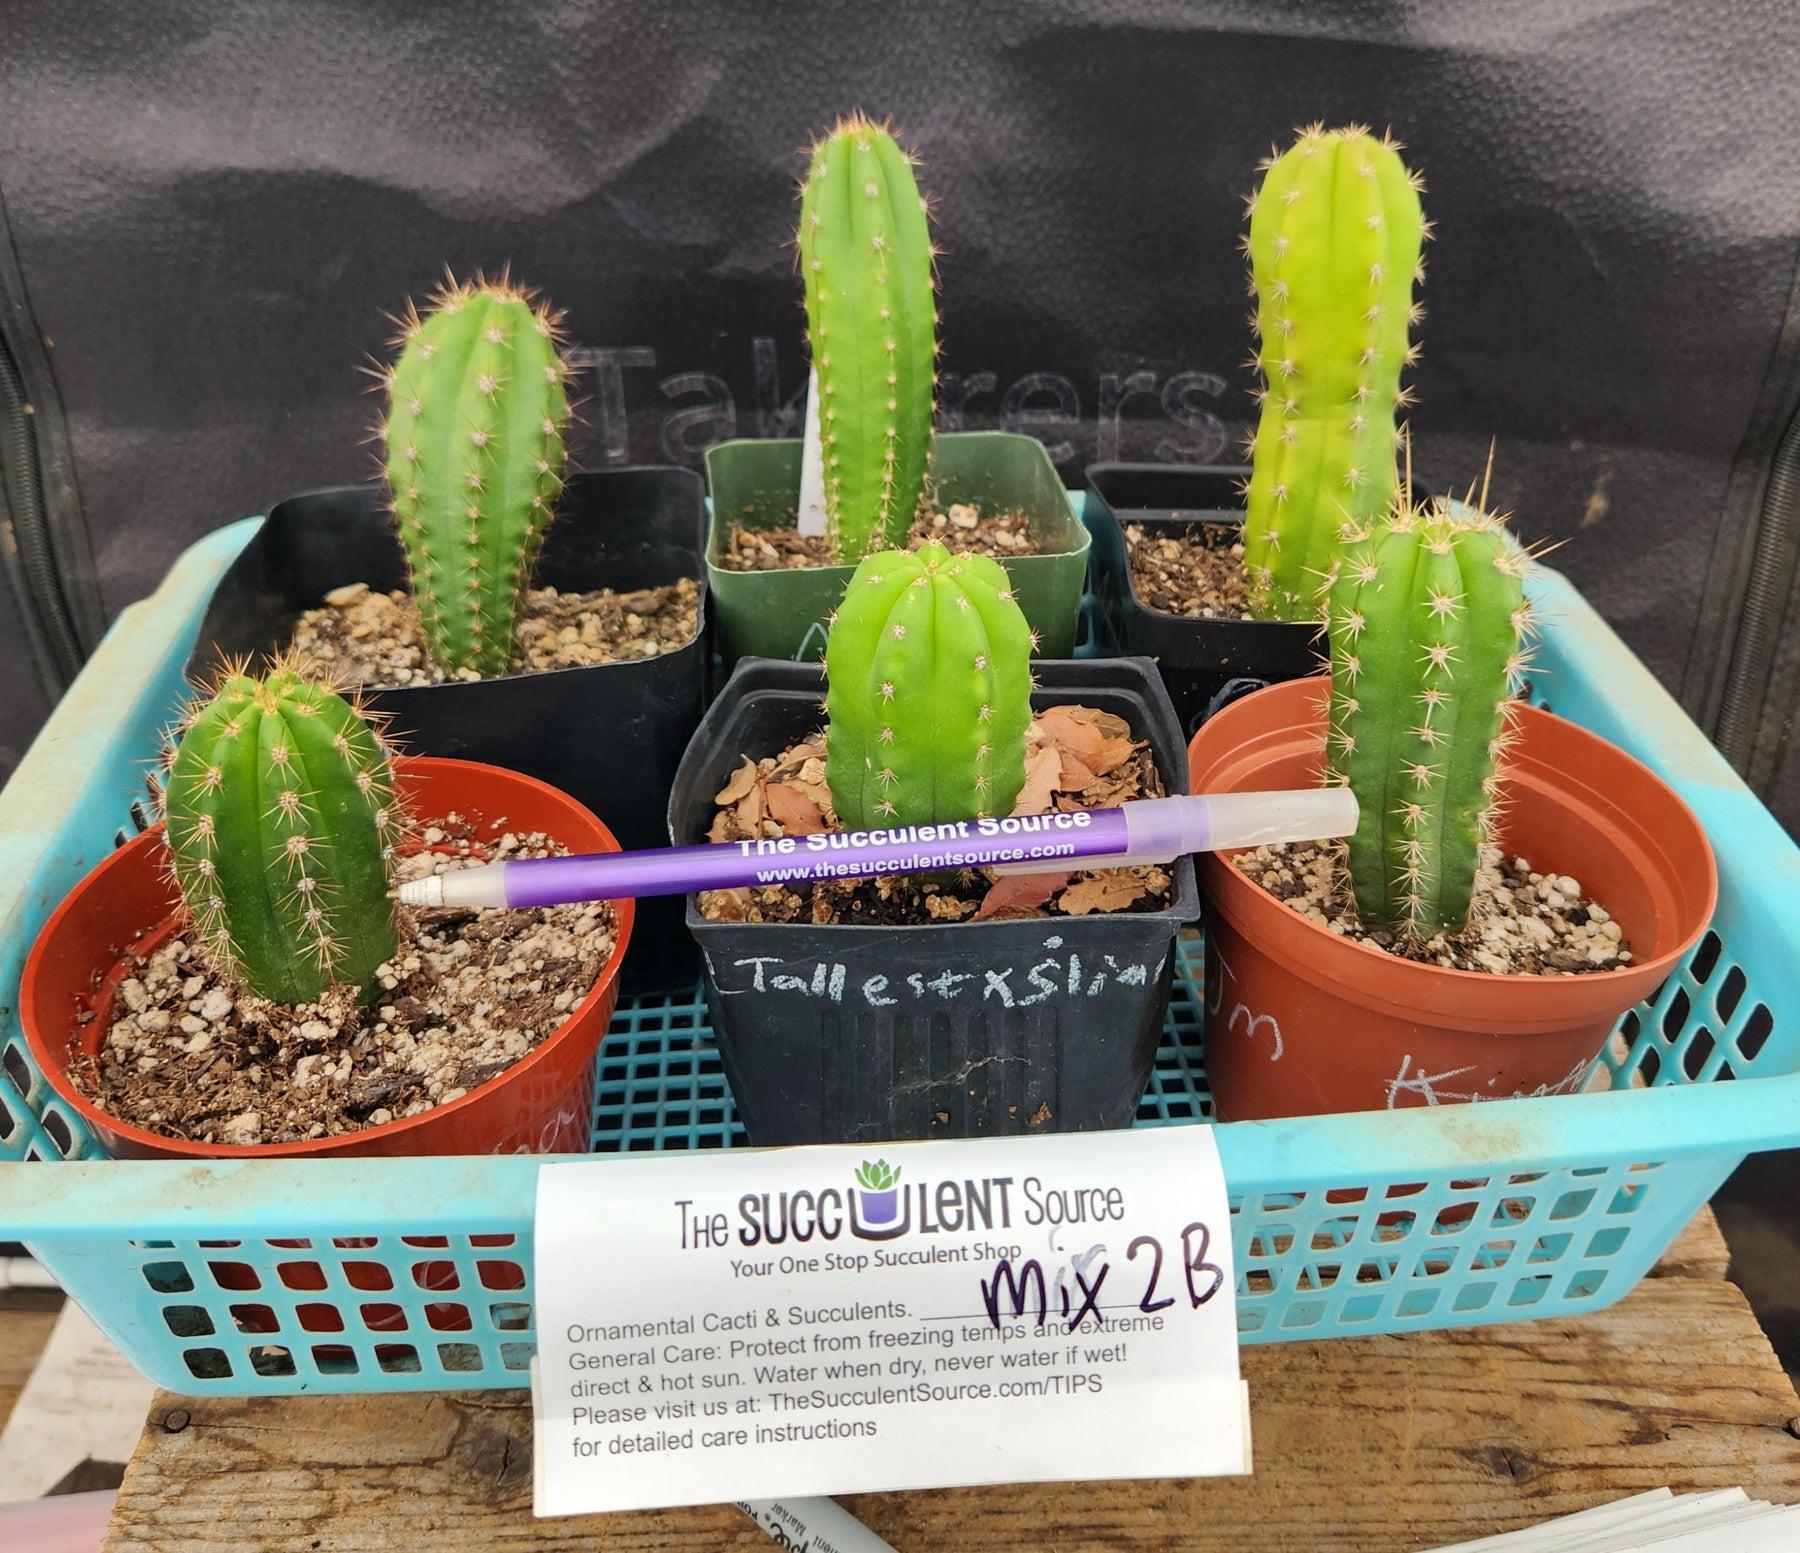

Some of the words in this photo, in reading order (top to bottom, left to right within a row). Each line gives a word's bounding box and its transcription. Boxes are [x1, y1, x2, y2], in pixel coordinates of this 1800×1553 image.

[735, 836, 796, 857] The
[806, 820, 969, 852] Succulent
[978, 810, 1091, 836] Source
[756, 841, 1075, 884] www.thesucculentsource.com
[1023, 1176, 1125, 1226] Source
[731, 1259, 775, 1279] Your
[780, 1256, 819, 1275] One
[825, 1252, 869, 1274] Stop
[874, 1245, 972, 1267] Succulent
[974, 1241, 1022, 1264] Shop
[567, 1314, 695, 1343] Ornamental
[703, 1309, 758, 1333] Cacti
[765, 1308, 780, 1327] &
[788, 1300, 912, 1325] Succulents.
[569, 1347, 655, 1371] General
[663, 1343, 721, 1364] Care:
[730, 1335, 807, 1359] Protect
[813, 1332, 861, 1352] from
[869, 1324, 954, 1348] freezing
[962, 1322, 1026, 1345] temps
[1033, 1316, 1072, 1338] and
[1079, 1312, 1164, 1336] extreme
[570, 1379, 630, 1398] direct
[638, 1375, 653, 1393] &
[661, 1372, 695, 1391] hot
[702, 1371, 746, 1388] sun.
[754, 1364, 818, 1385] Water
[824, 1359, 882, 1380] when
[889, 1355, 927, 1379] dry,
[934, 1353, 995, 1372] never
[1001, 1348, 1059, 1368] water
[1066, 1344, 1079, 1364] if
[1084, 1342, 1127, 1364] wet!
[572, 1402, 647, 1426] Please
[654, 1399, 697, 1420] visit
[704, 1399, 728, 1417] us
[736, 1396, 761, 1415] at:
[769, 1373, 1103, 1412] TheSucculentSource.com/TIPS
[572, 1436, 601, 1458] for
[608, 1428, 693, 1455] detailed
[701, 1430, 748, 1449] care
[755, 1417, 878, 1445] instructions
[771, 1502, 807, 1537] Marker
